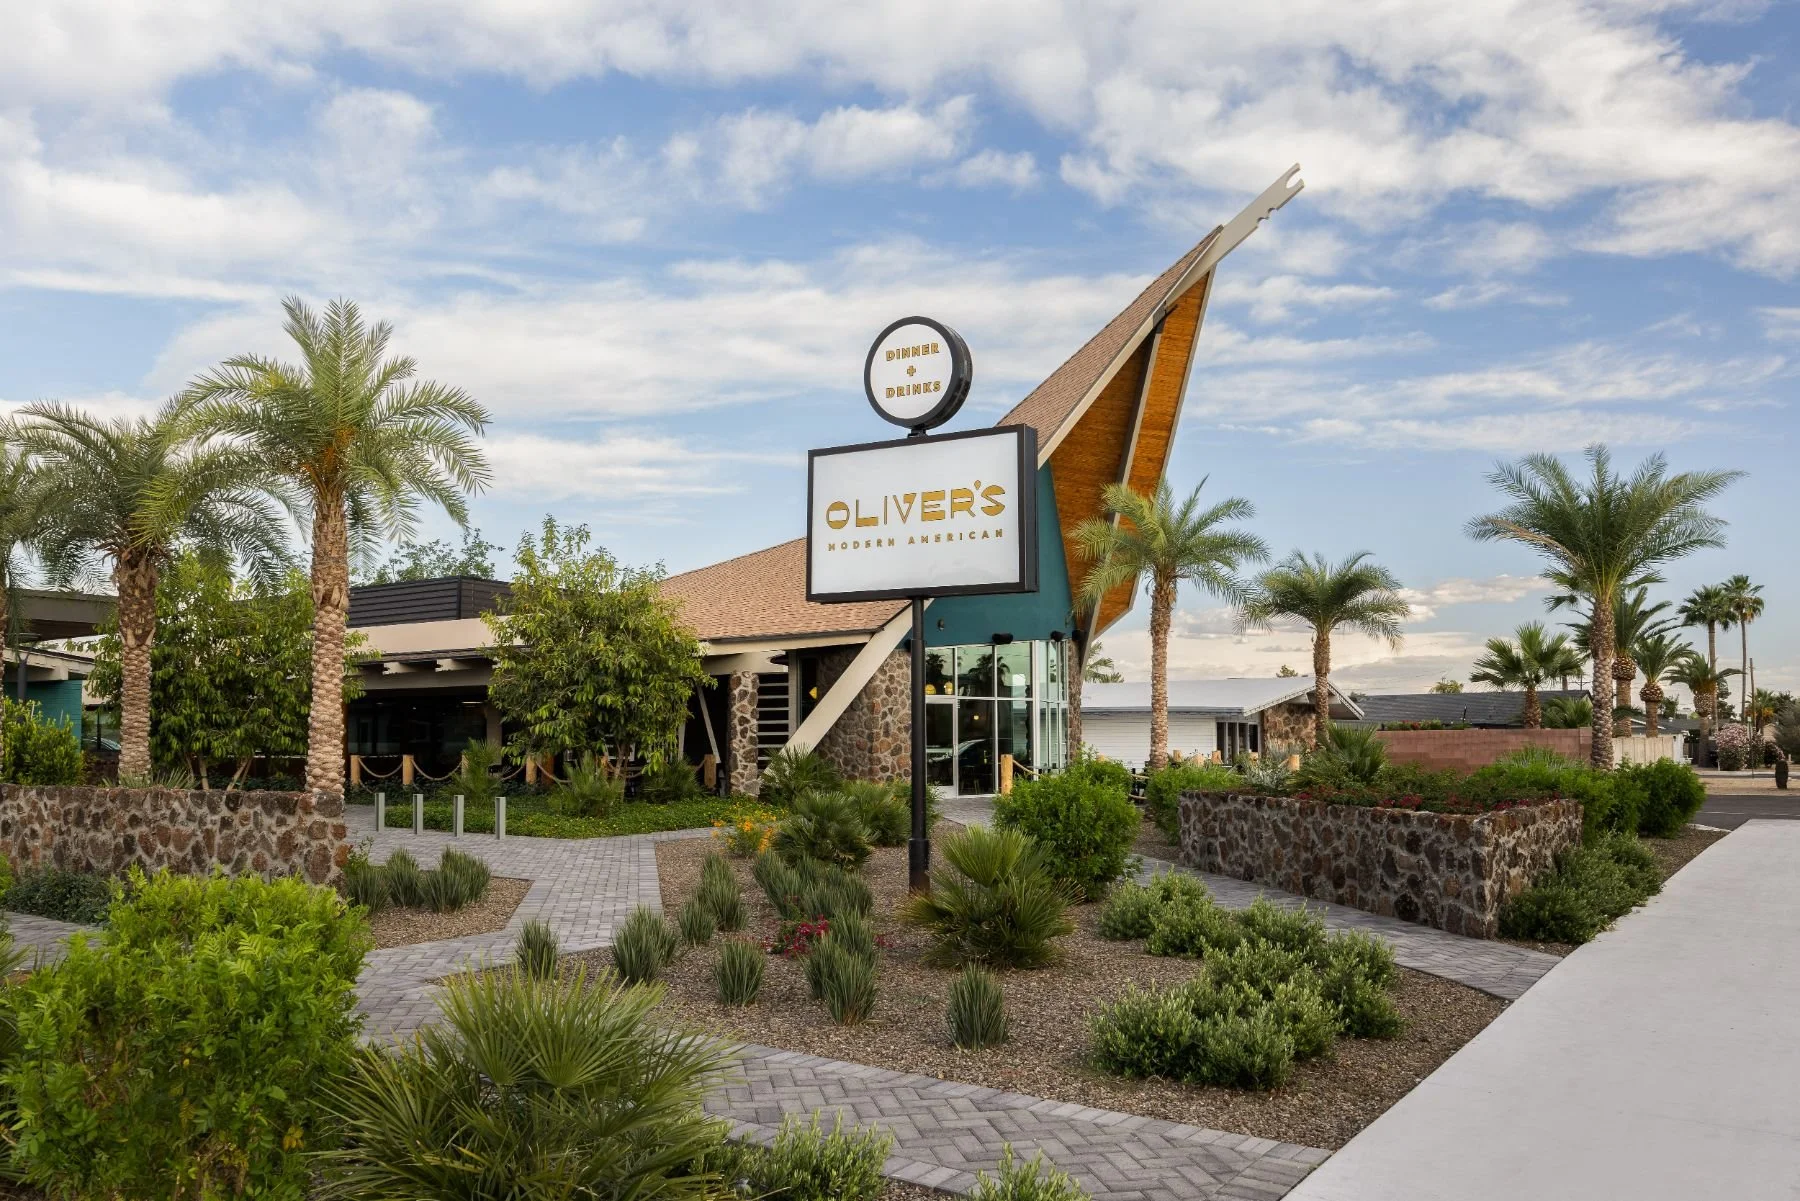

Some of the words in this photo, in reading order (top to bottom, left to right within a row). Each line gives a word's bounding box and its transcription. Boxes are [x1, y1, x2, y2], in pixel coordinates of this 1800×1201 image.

[885, 342, 940, 361] DINNER
[906, 365, 917, 377] +
[885, 381, 941, 398] DRINKS
[826, 480, 1005, 530] OLIVER'S
[828, 537, 895, 552] MODERN
[908, 528, 1003, 545] AMERICAN
